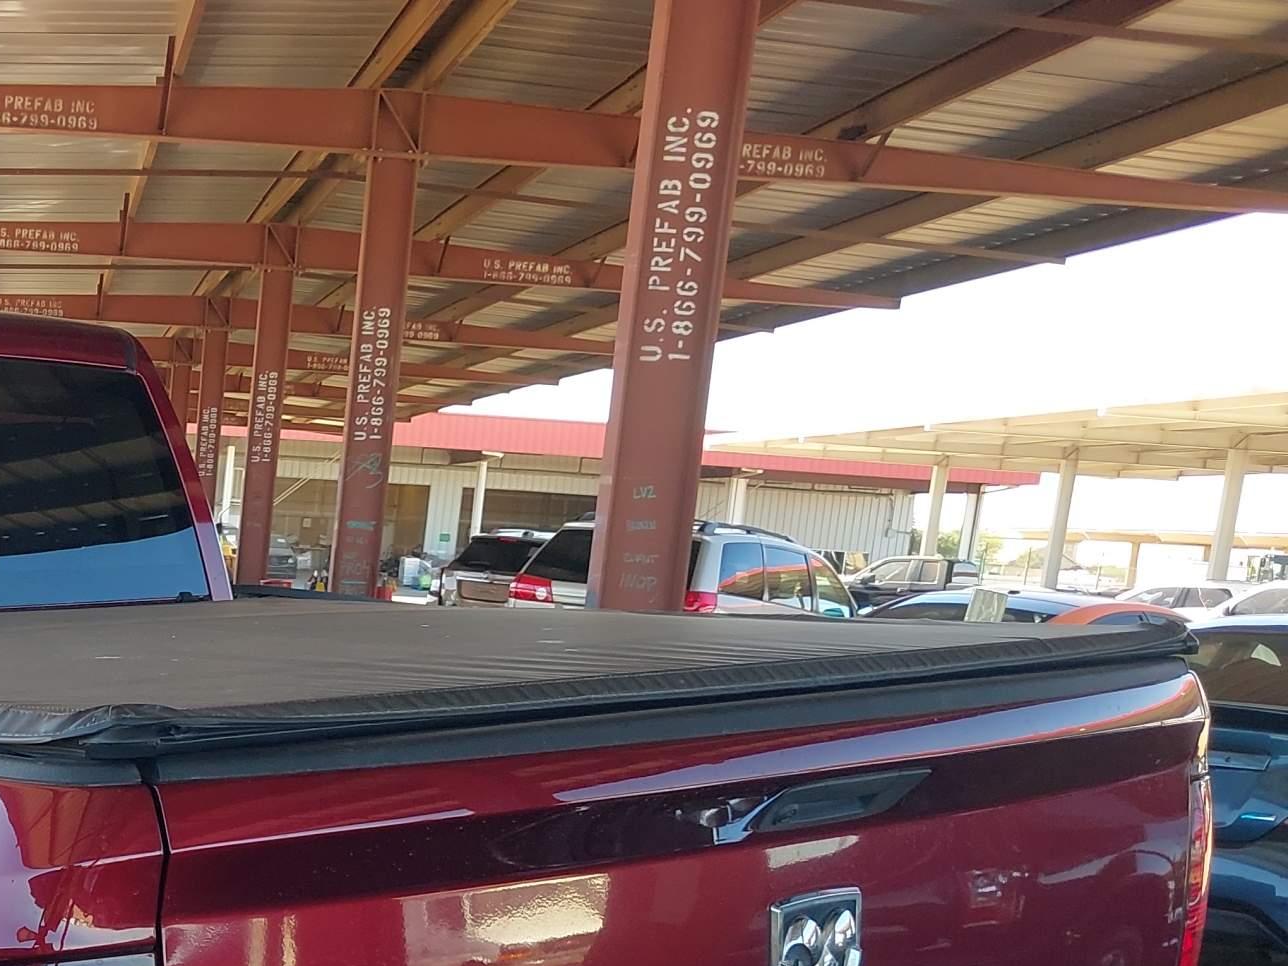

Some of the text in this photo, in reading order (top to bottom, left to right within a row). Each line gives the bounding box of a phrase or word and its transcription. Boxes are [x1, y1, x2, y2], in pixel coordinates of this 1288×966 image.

[4, 95, 64, 112] PREFAB
[15, 228, 55, 241] PREFAB
[639, 107, 692, 362] U.S. PREFAB INC.
[668, 110, 720, 360] 1-866-799-0969
[357, 343, 374, 403] PREFAB
[369, 307, 392, 440] 1-866-799-0969
[253, 395, 266, 437] PREFAB
